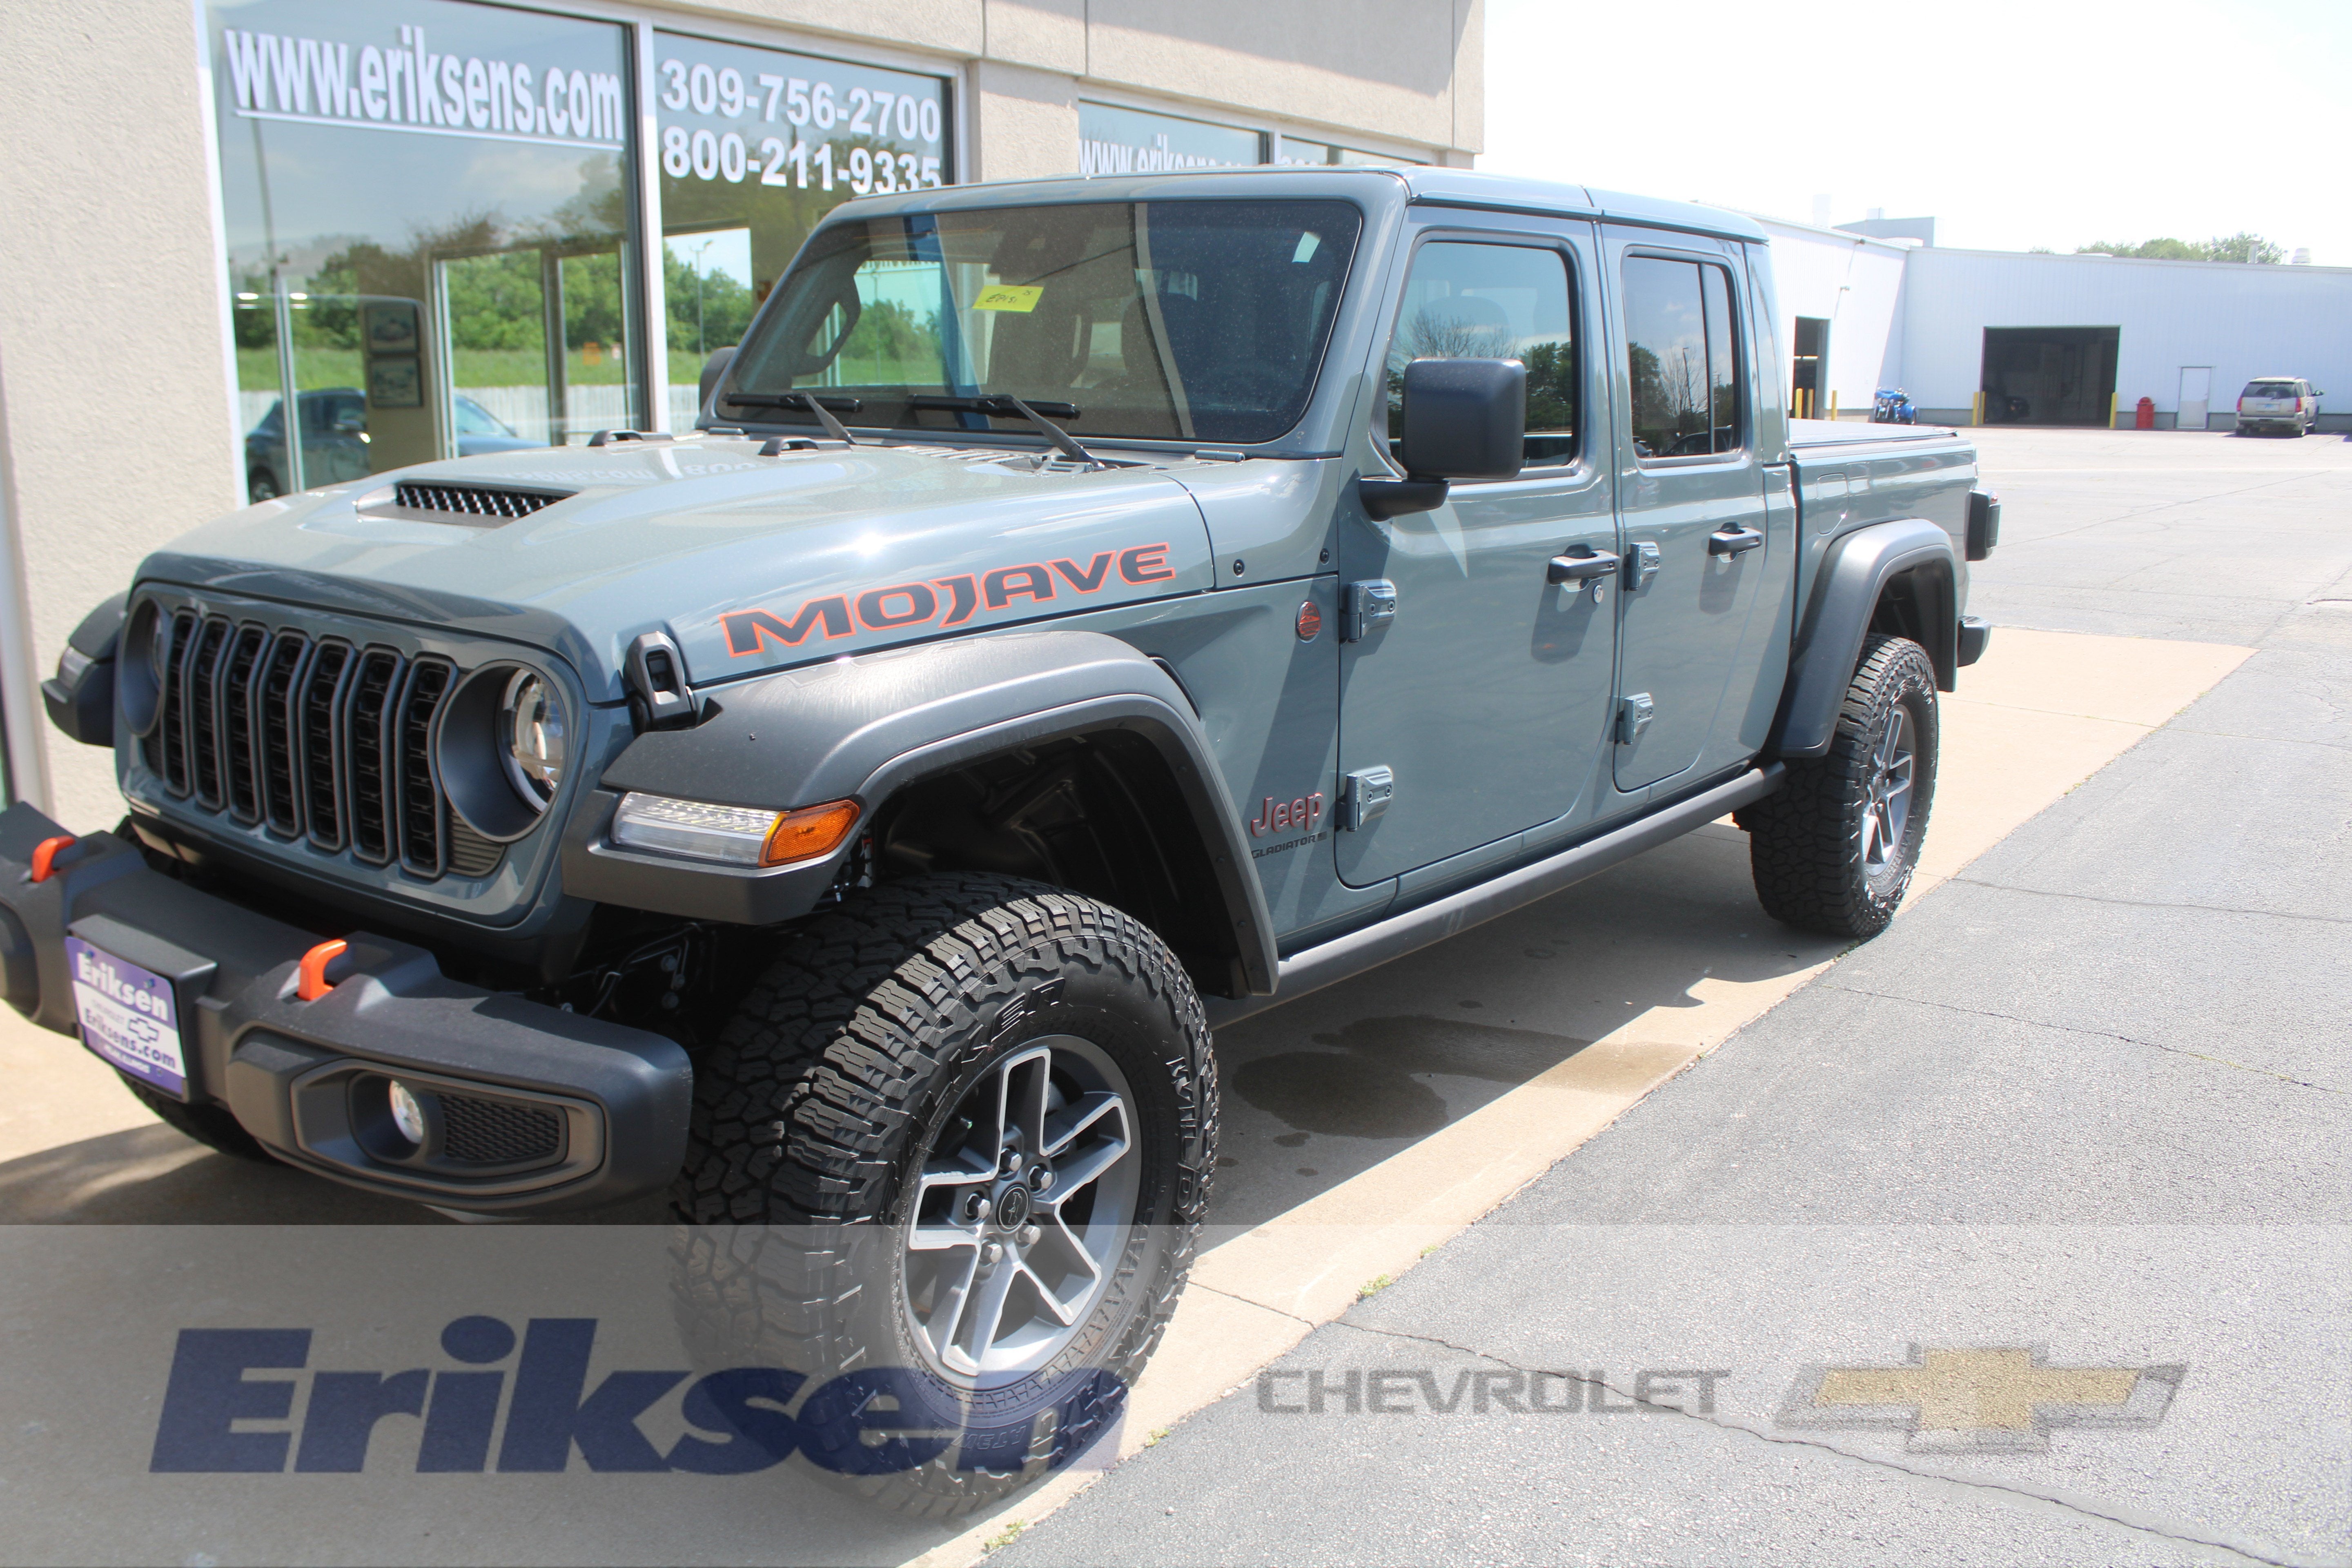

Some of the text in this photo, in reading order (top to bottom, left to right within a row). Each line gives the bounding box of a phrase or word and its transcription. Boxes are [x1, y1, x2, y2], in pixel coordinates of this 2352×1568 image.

[225, 25, 624, 141] www.eriksens.com
[661, 58, 941, 143] 309-756-2700
[663, 126, 942, 195] 800-211-9335
[719, 542, 1176, 658] MOJAVE
[1251, 792, 1324, 837] Jeep
[1251, 834, 1316, 859] GLADIATOR
[77, 952, 169, 1022] Eriksen
[84, 1007, 176, 1069] Eriksens.com
